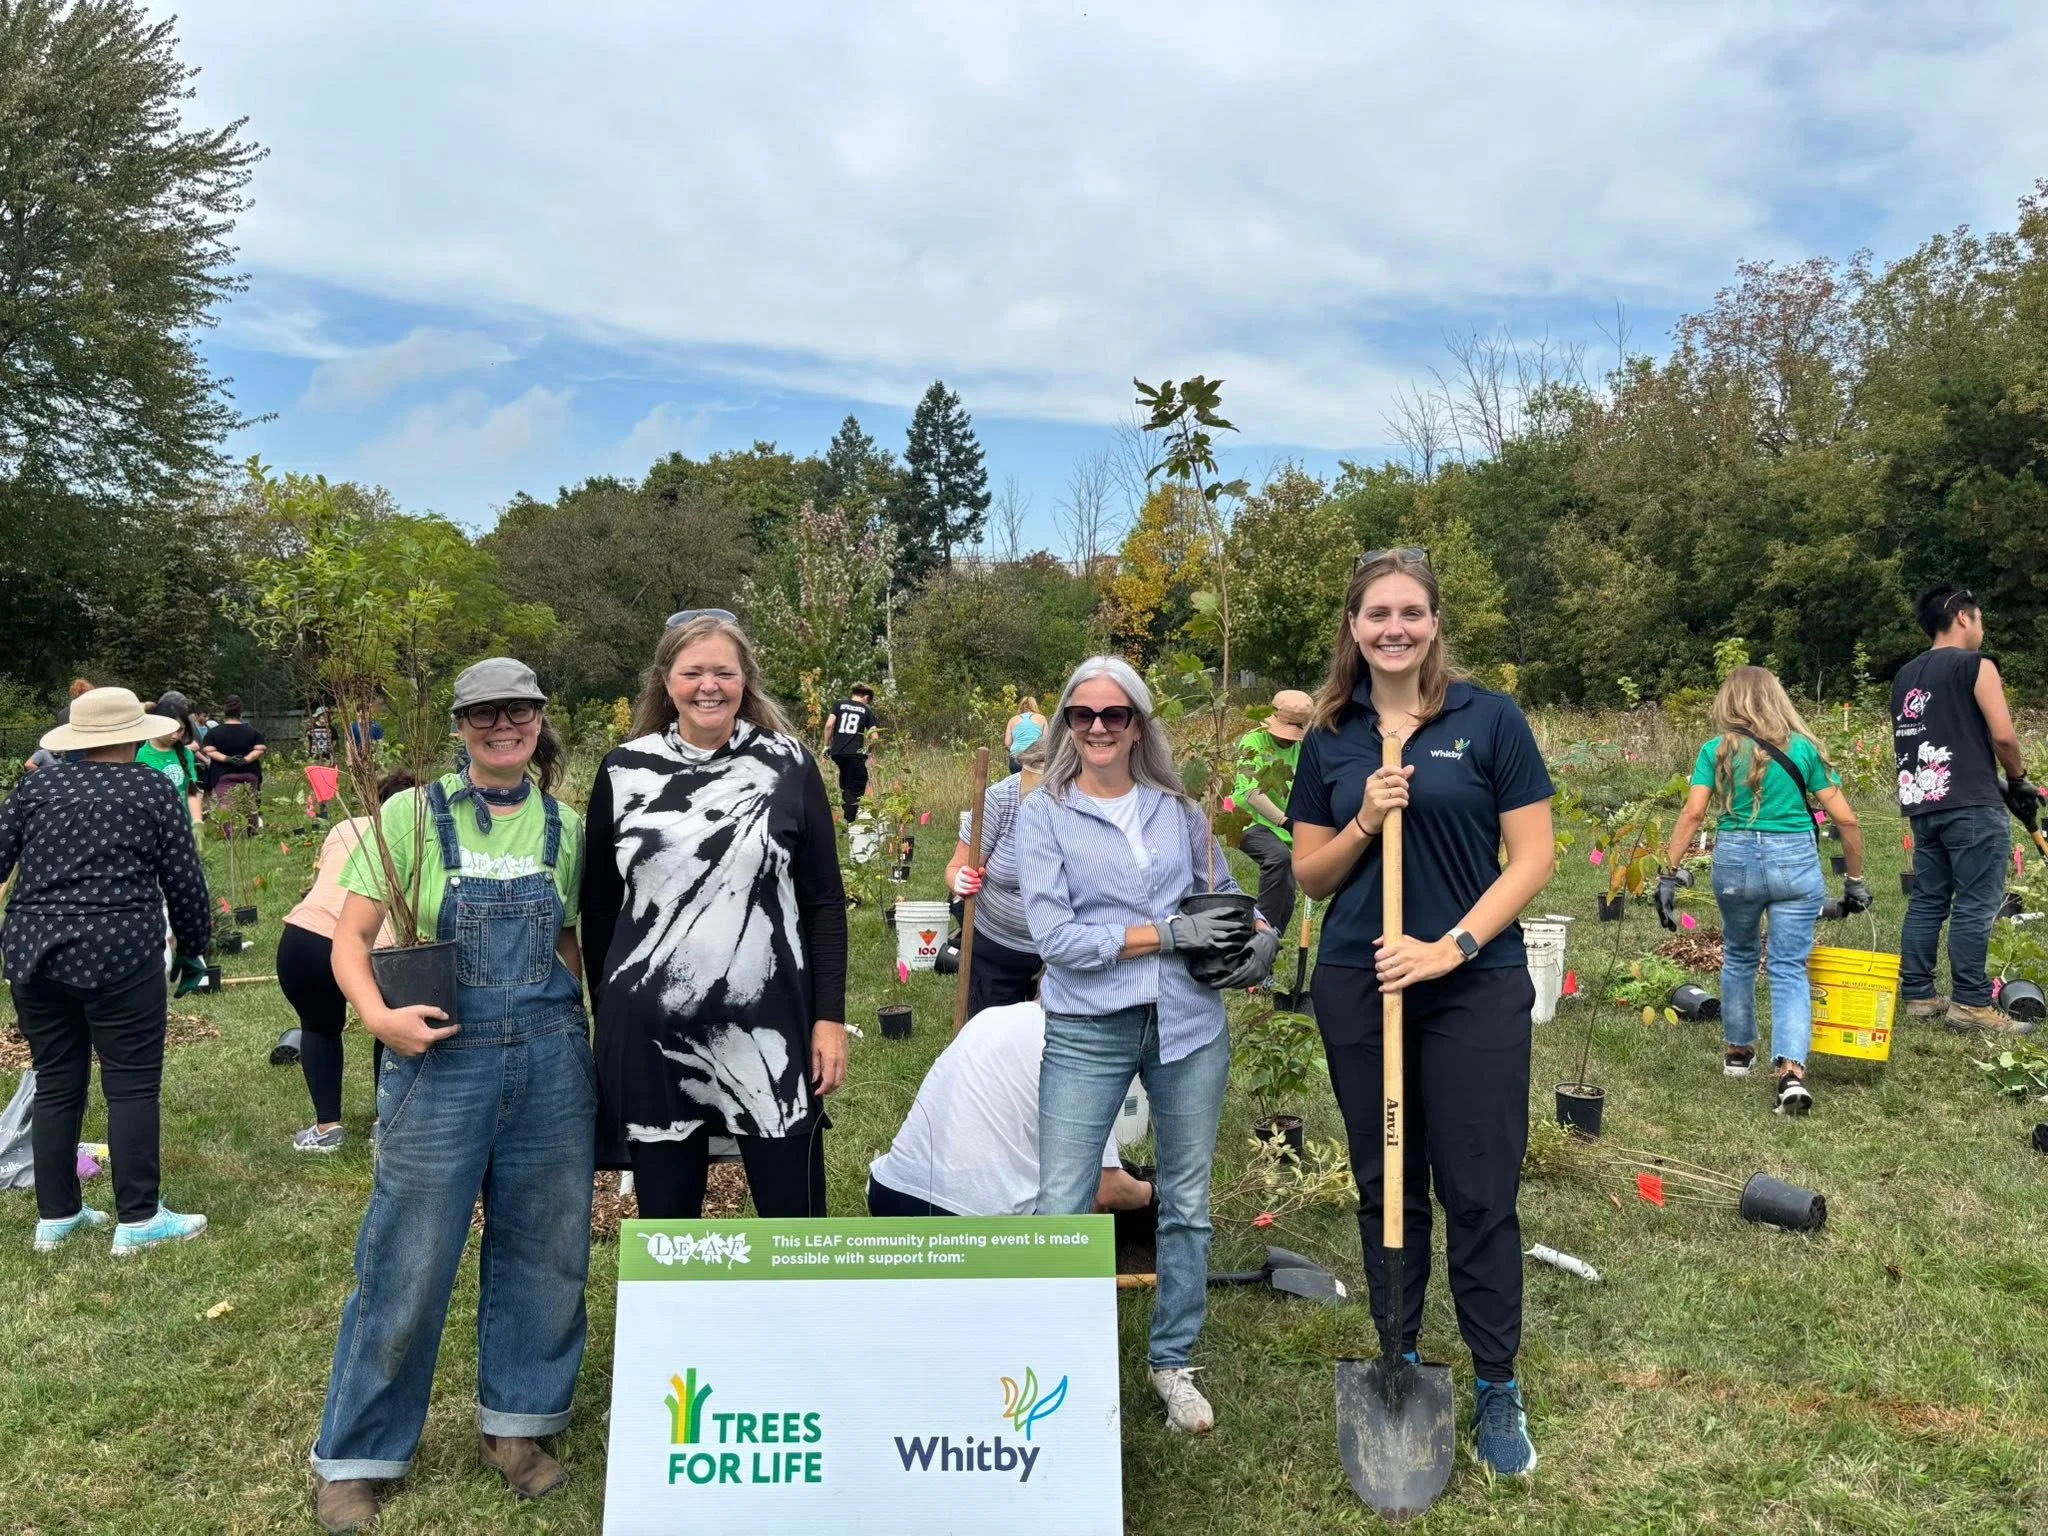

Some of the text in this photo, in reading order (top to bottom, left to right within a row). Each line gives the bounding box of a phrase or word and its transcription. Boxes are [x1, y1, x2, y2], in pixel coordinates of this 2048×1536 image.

[838, 712, 860, 734] 18
[1430, 750, 1463, 760] Whitby
[918, 947, 937, 956] 100
[1386, 1097, 1399, 1147] Anvil
[652, 1234, 746, 1260] LEAF
[772, 1232, 1089, 1248] This LEAF community planting event is made
[771, 1251, 965, 1267] possible with support from:
[712, 1412, 822, 1443] TREES
[668, 1452, 822, 1484] FOR LIFE
[893, 1435, 1041, 1482] Whitby
